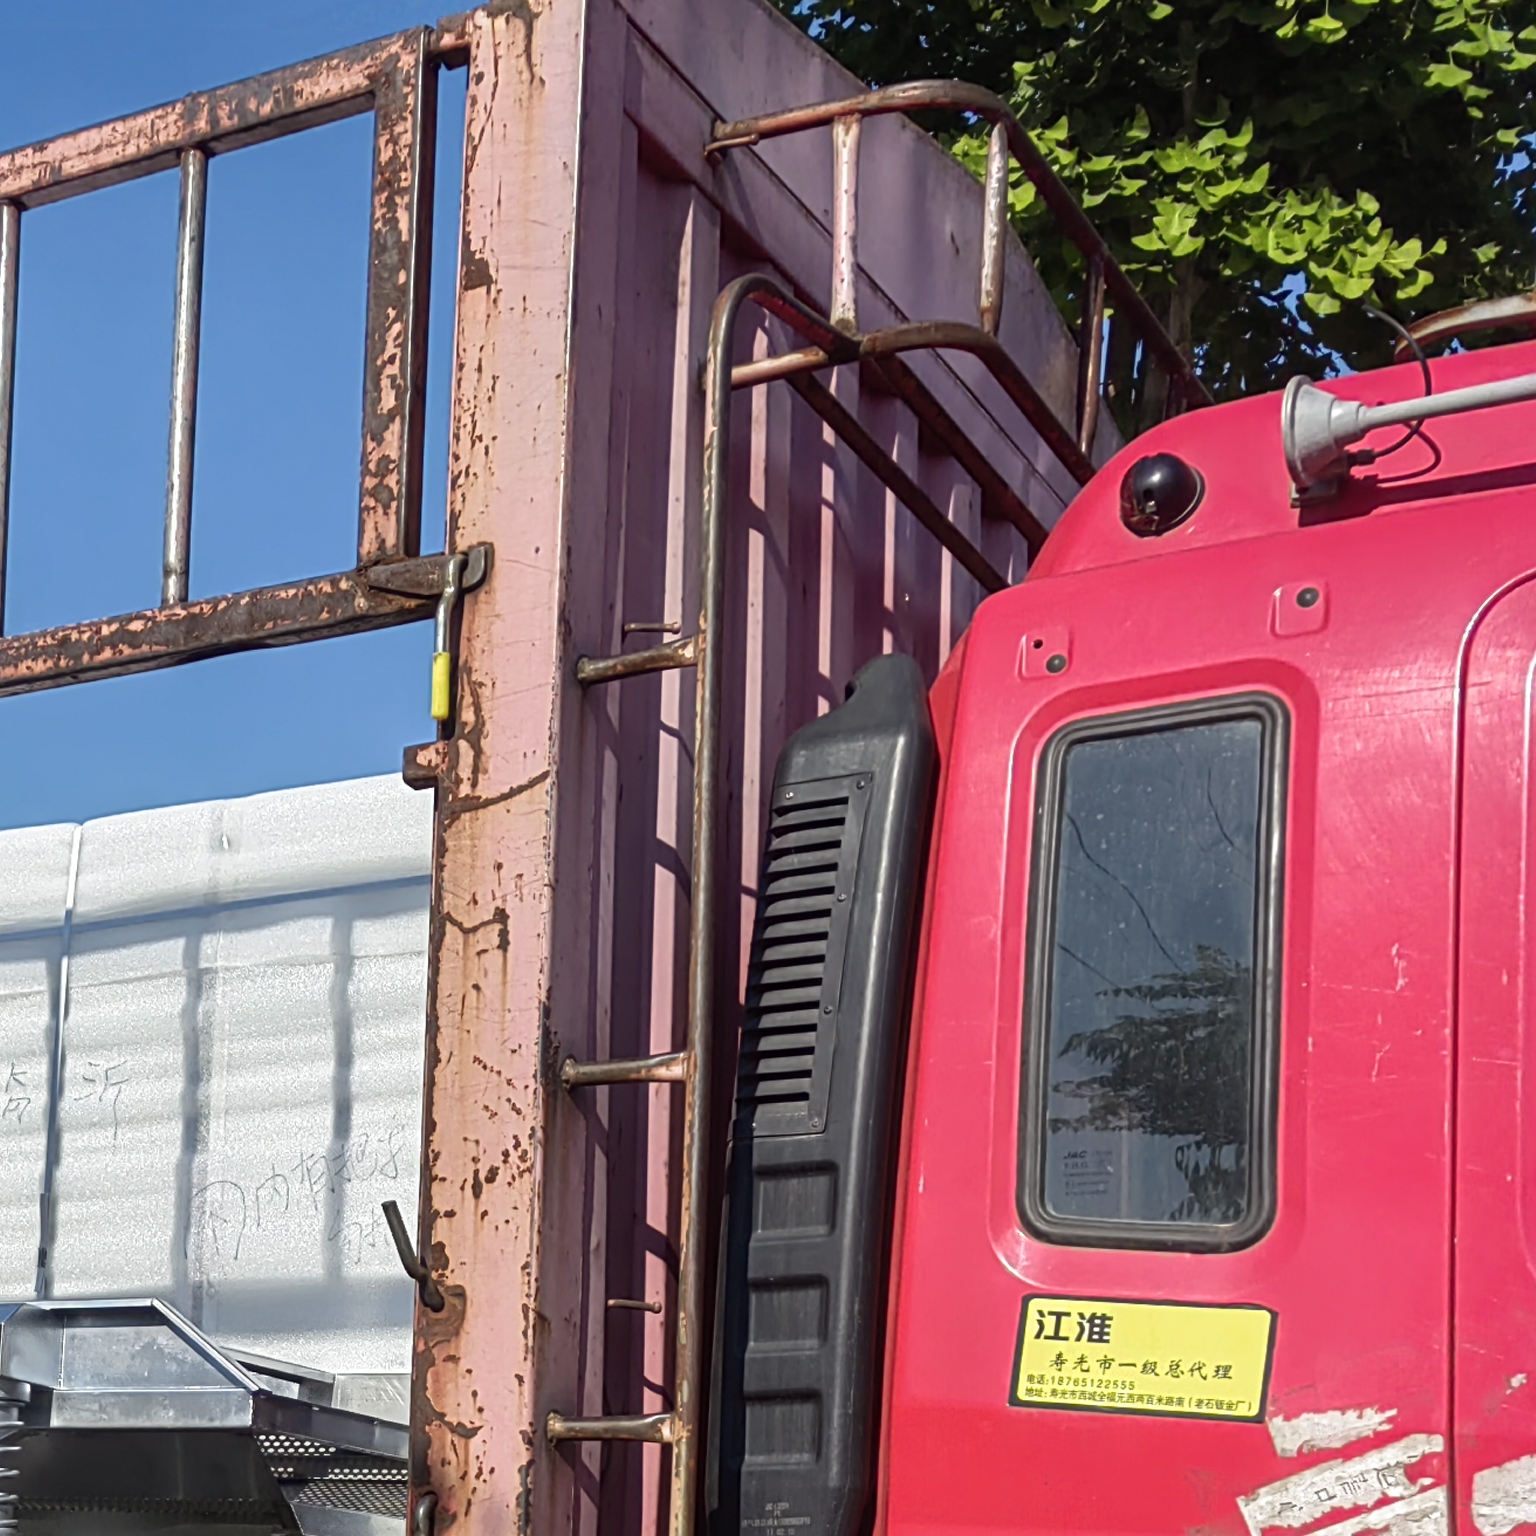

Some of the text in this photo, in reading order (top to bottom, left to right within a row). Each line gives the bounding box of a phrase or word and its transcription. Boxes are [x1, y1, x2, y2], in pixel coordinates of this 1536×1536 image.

[1033, 1309, 1114, 1344] 江淮
[1048, 1350, 1234, 1381] 寿光市一级总代理
